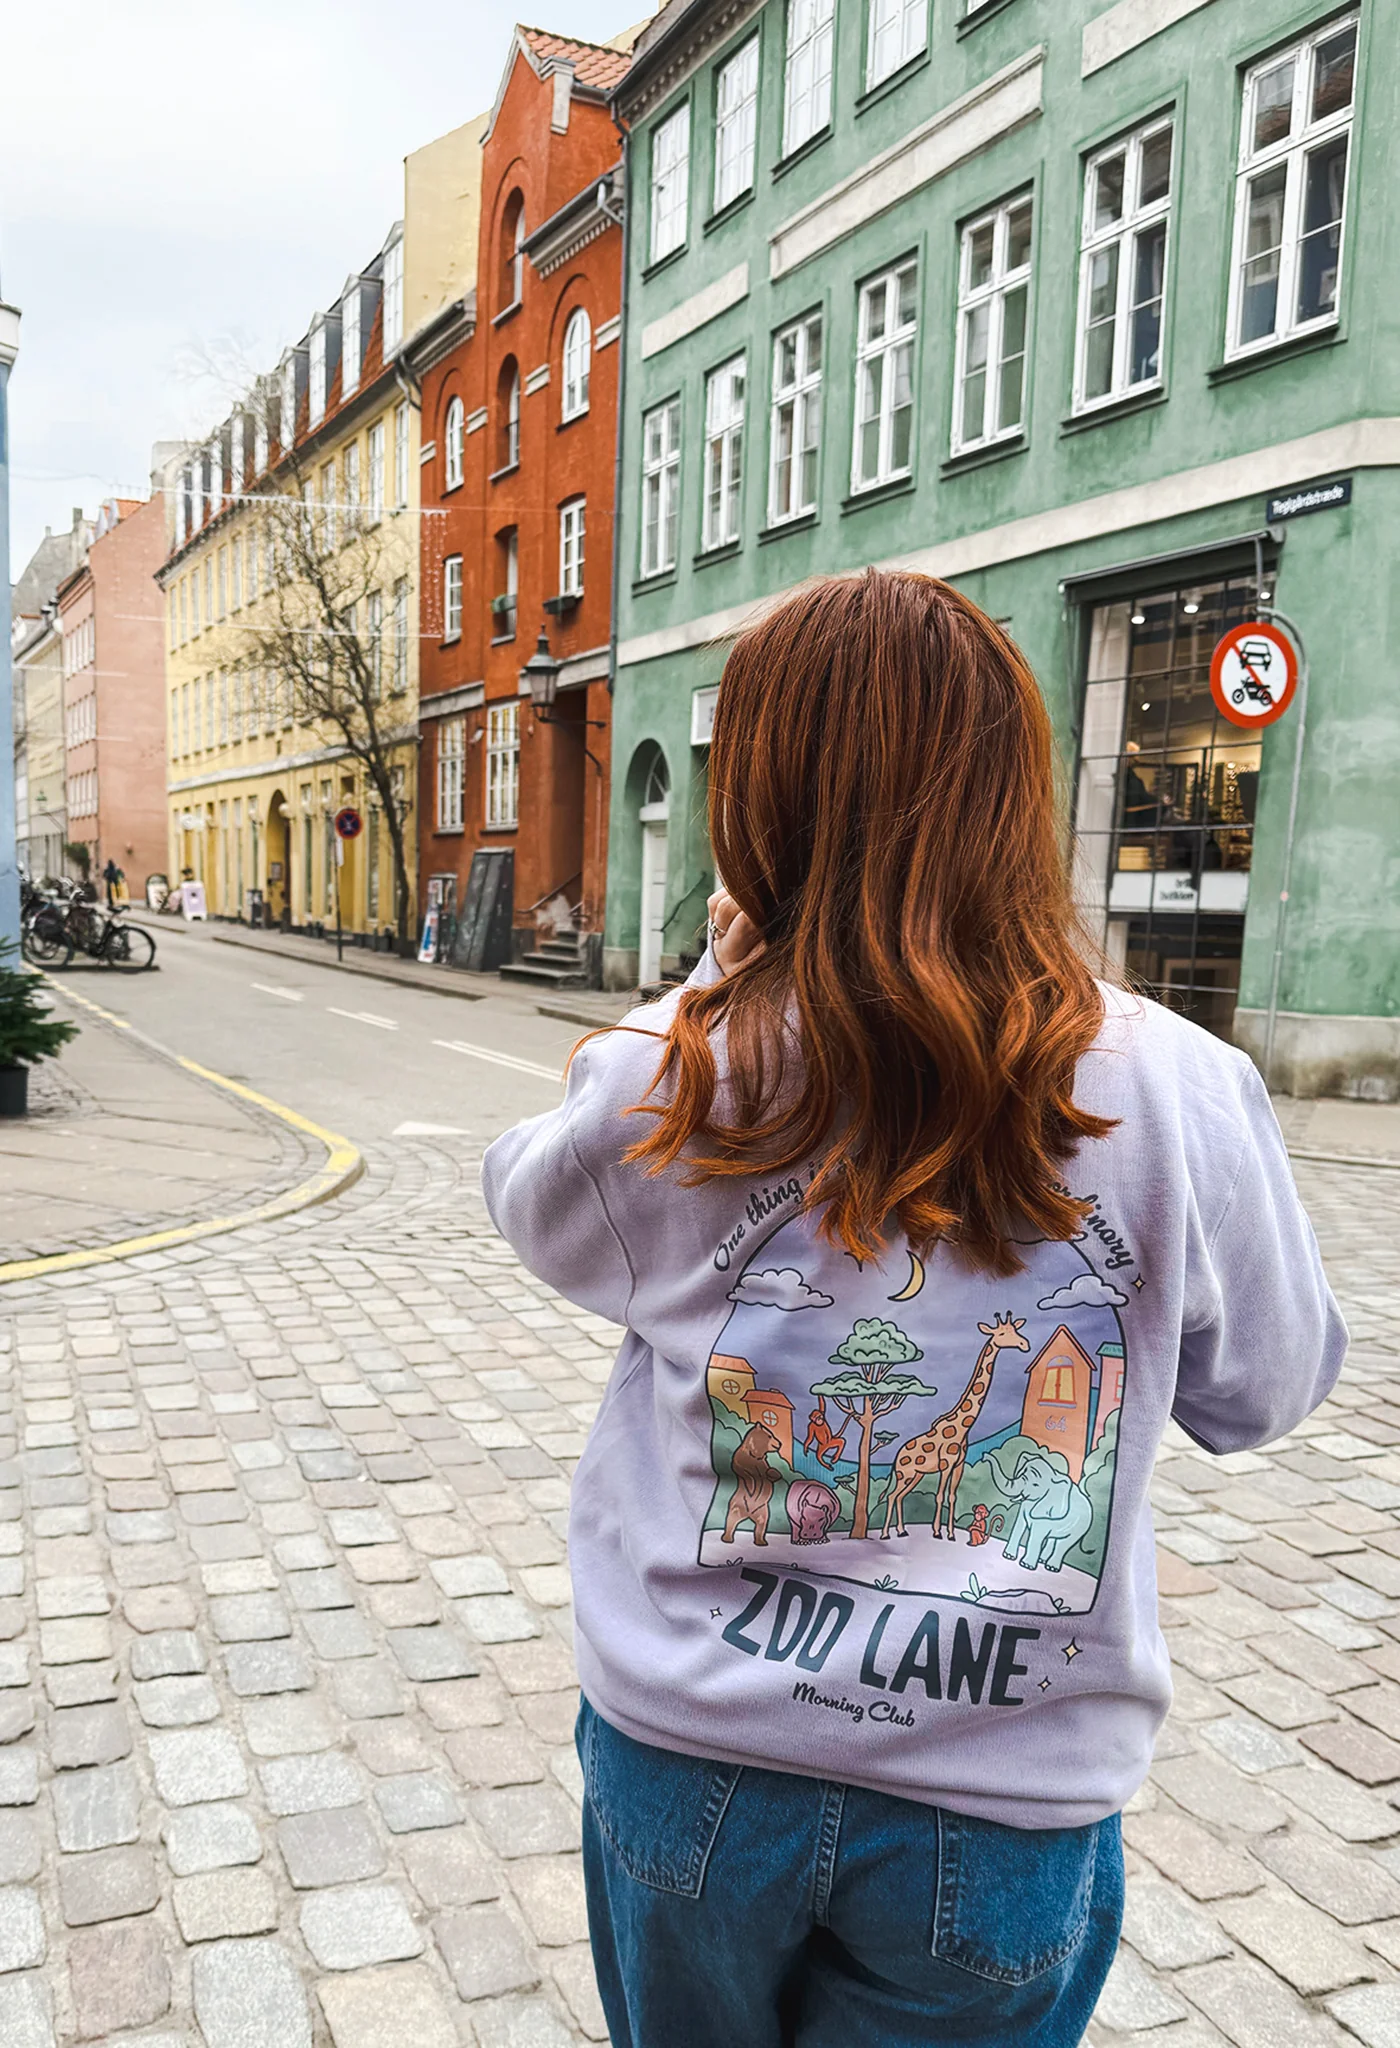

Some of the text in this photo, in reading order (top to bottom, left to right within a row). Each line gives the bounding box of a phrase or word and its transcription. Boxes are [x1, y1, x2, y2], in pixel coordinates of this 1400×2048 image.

[713, 1223, 746, 1272] One
[745, 1178, 805, 1226] thing
[1045, 1415, 1067, 1432] 64
[721, 1567, 1041, 1706] ZOO LANE
[792, 1682, 915, 1728] Morning Club
